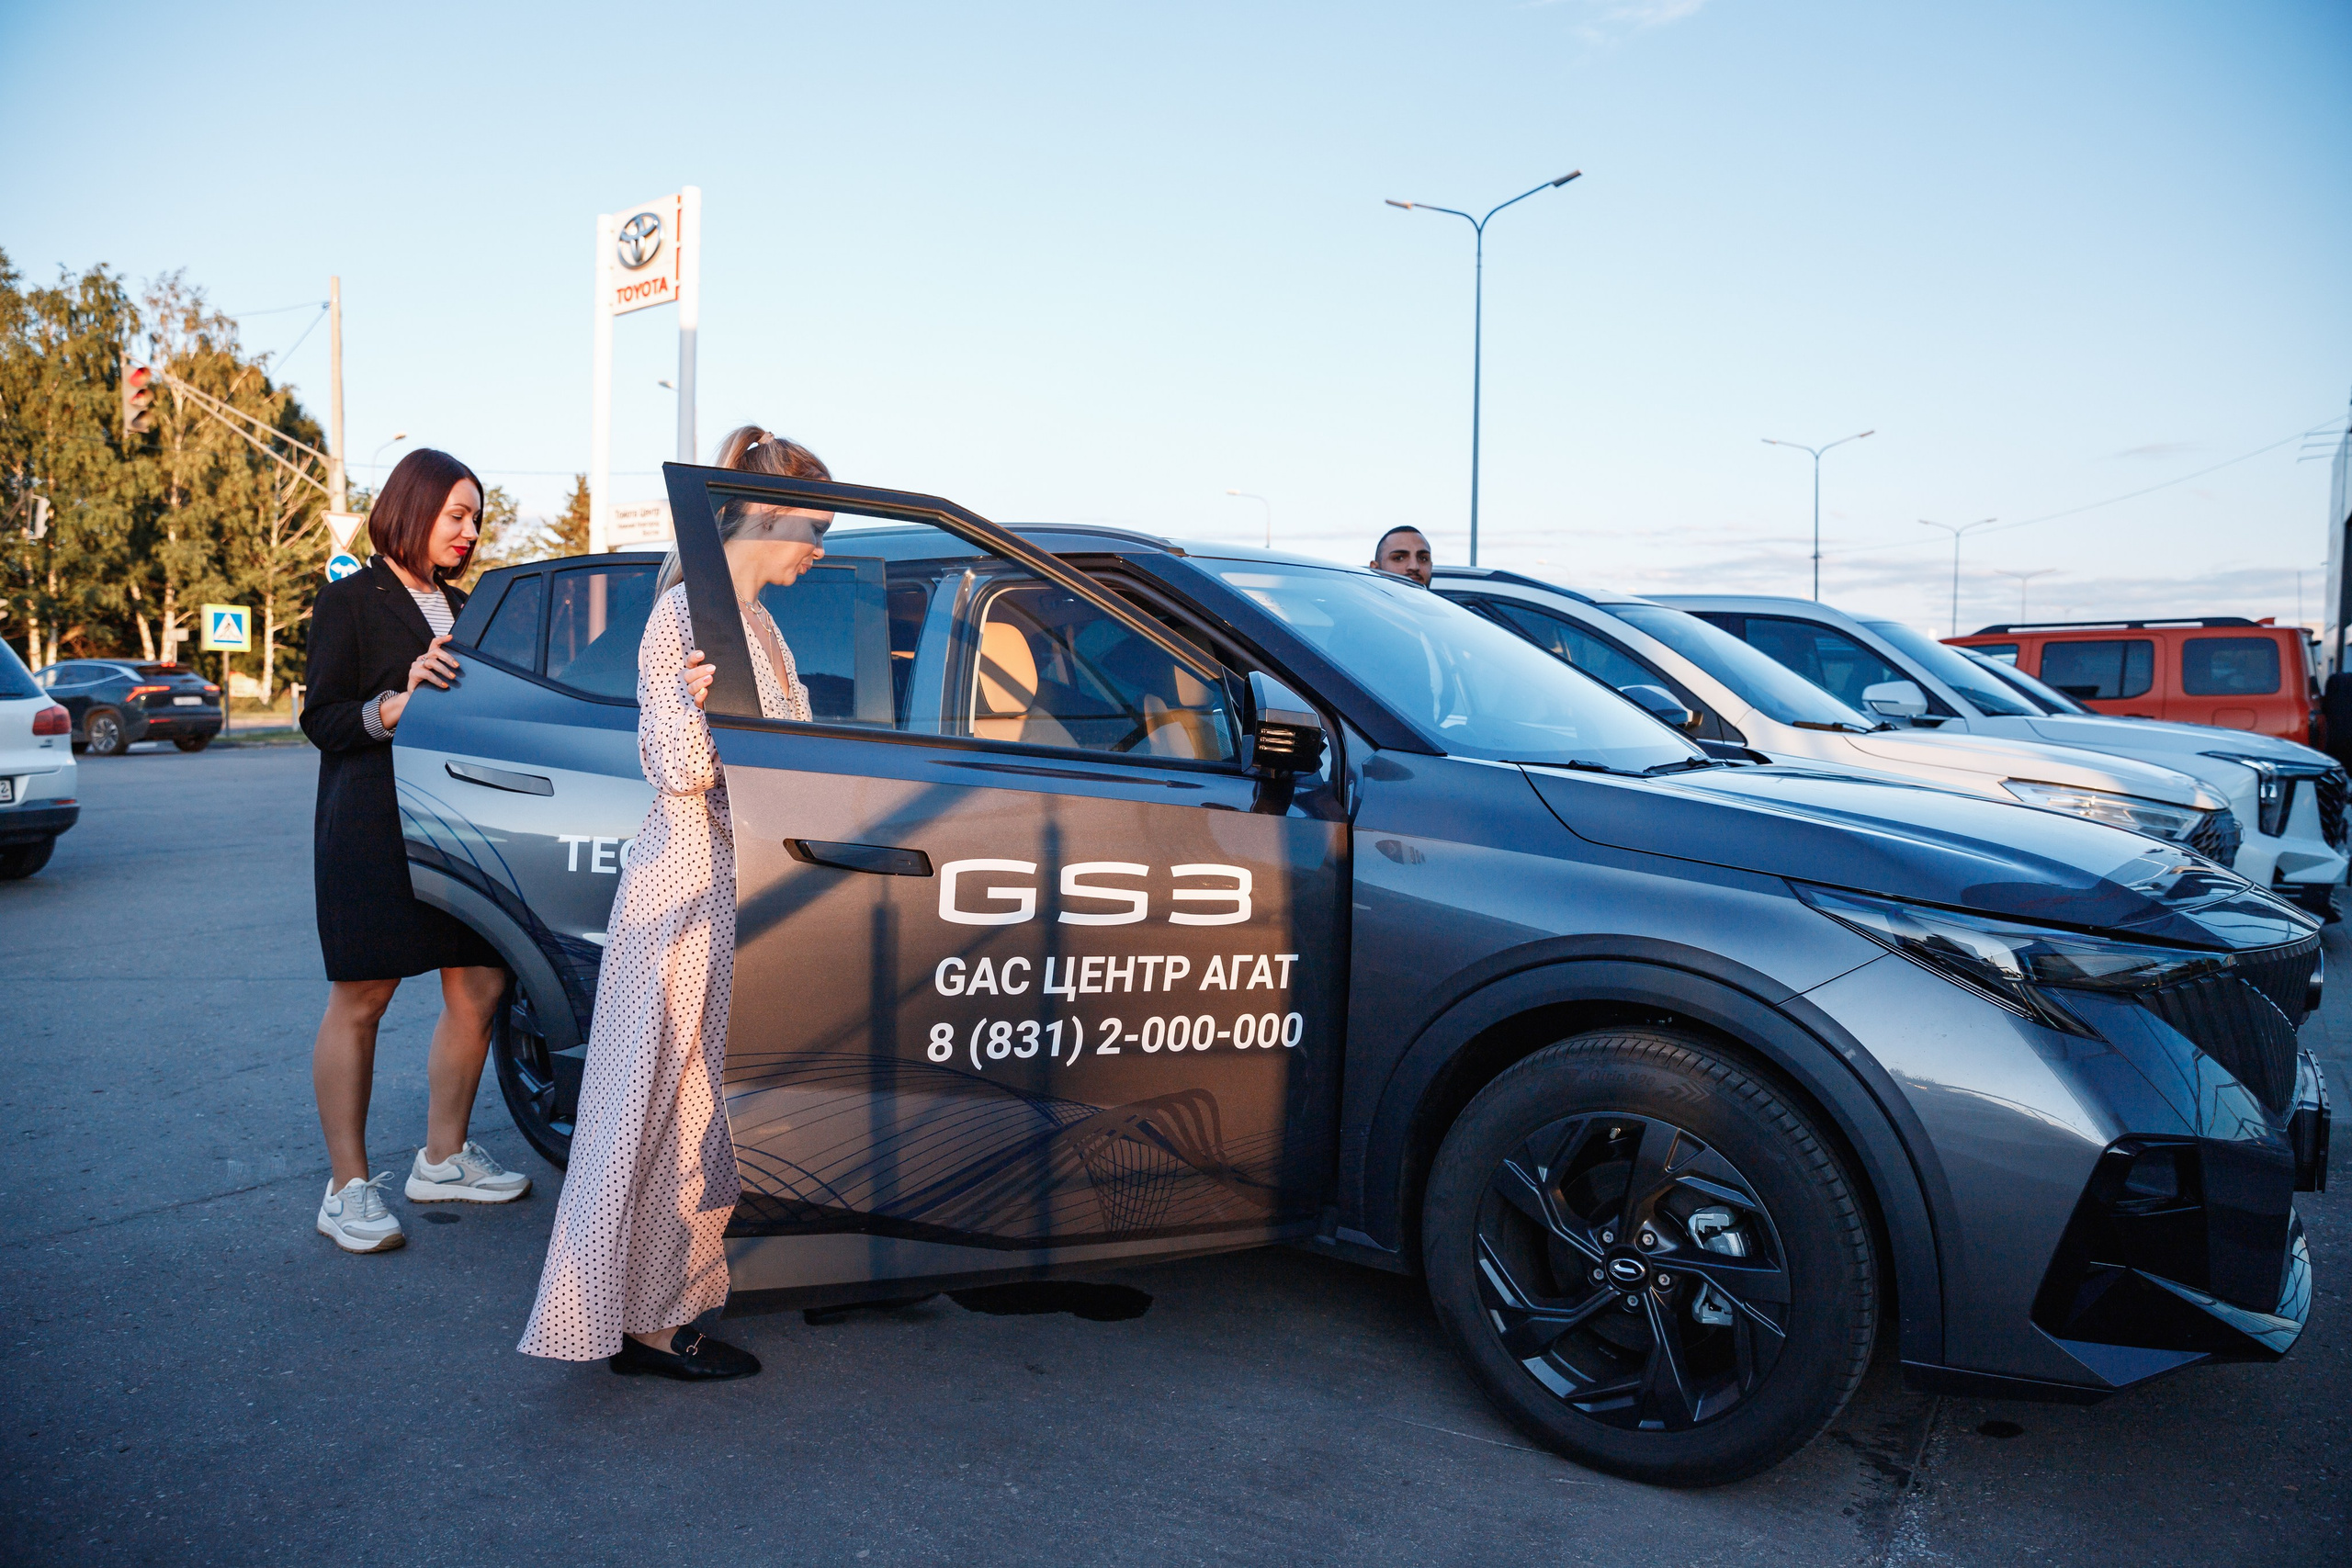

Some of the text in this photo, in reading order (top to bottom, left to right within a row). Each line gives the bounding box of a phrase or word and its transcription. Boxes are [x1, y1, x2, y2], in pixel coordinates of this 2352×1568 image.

[616, 276, 668, 304] TOYOTA
[938, 858, 1252, 926] GS3
[934, 953, 1299, 1002] GAC ЦЕНТР АГАТ
[927, 1011, 1304, 1071] 8 (831) 2-000-000
